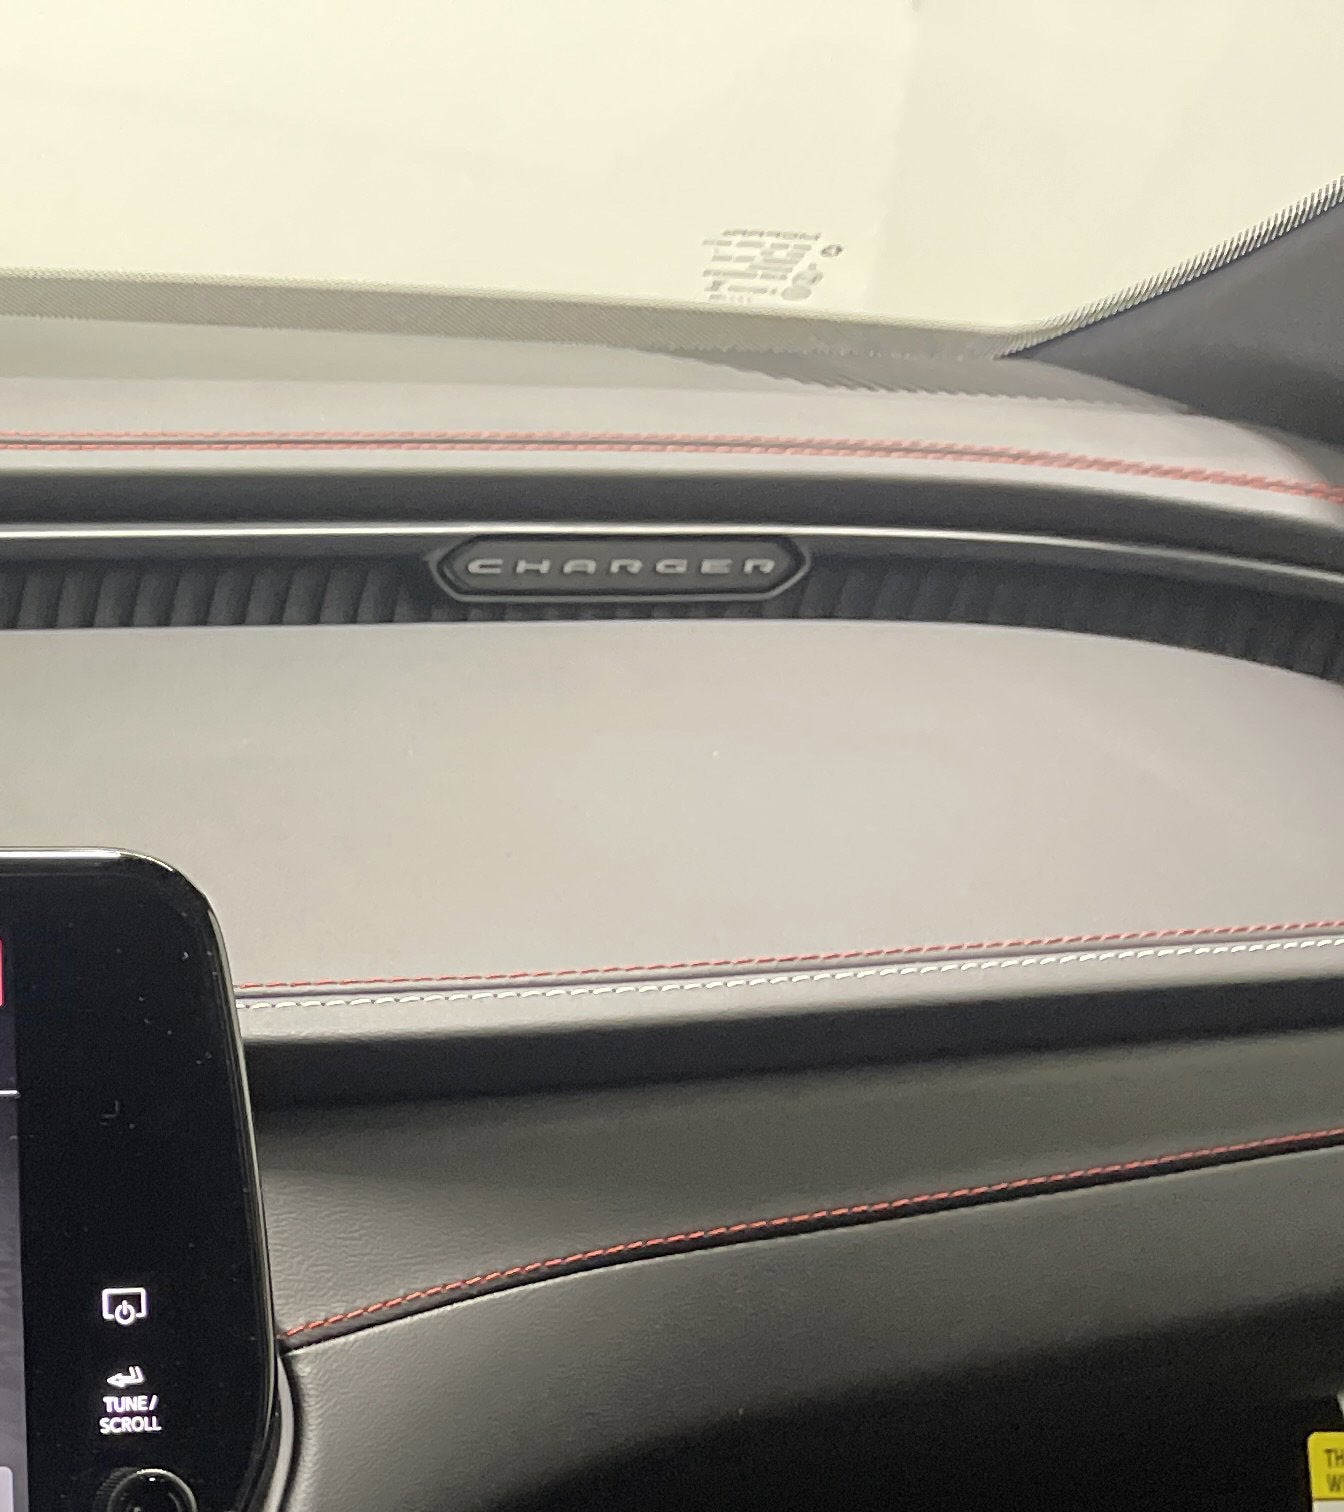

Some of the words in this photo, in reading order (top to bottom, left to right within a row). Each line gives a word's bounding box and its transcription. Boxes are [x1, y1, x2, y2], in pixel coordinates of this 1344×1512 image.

[467, 557, 776, 576] CHARGER
[102, 1394, 159, 1414] TUNE/
[98, 1415, 163, 1435] SCROLL
